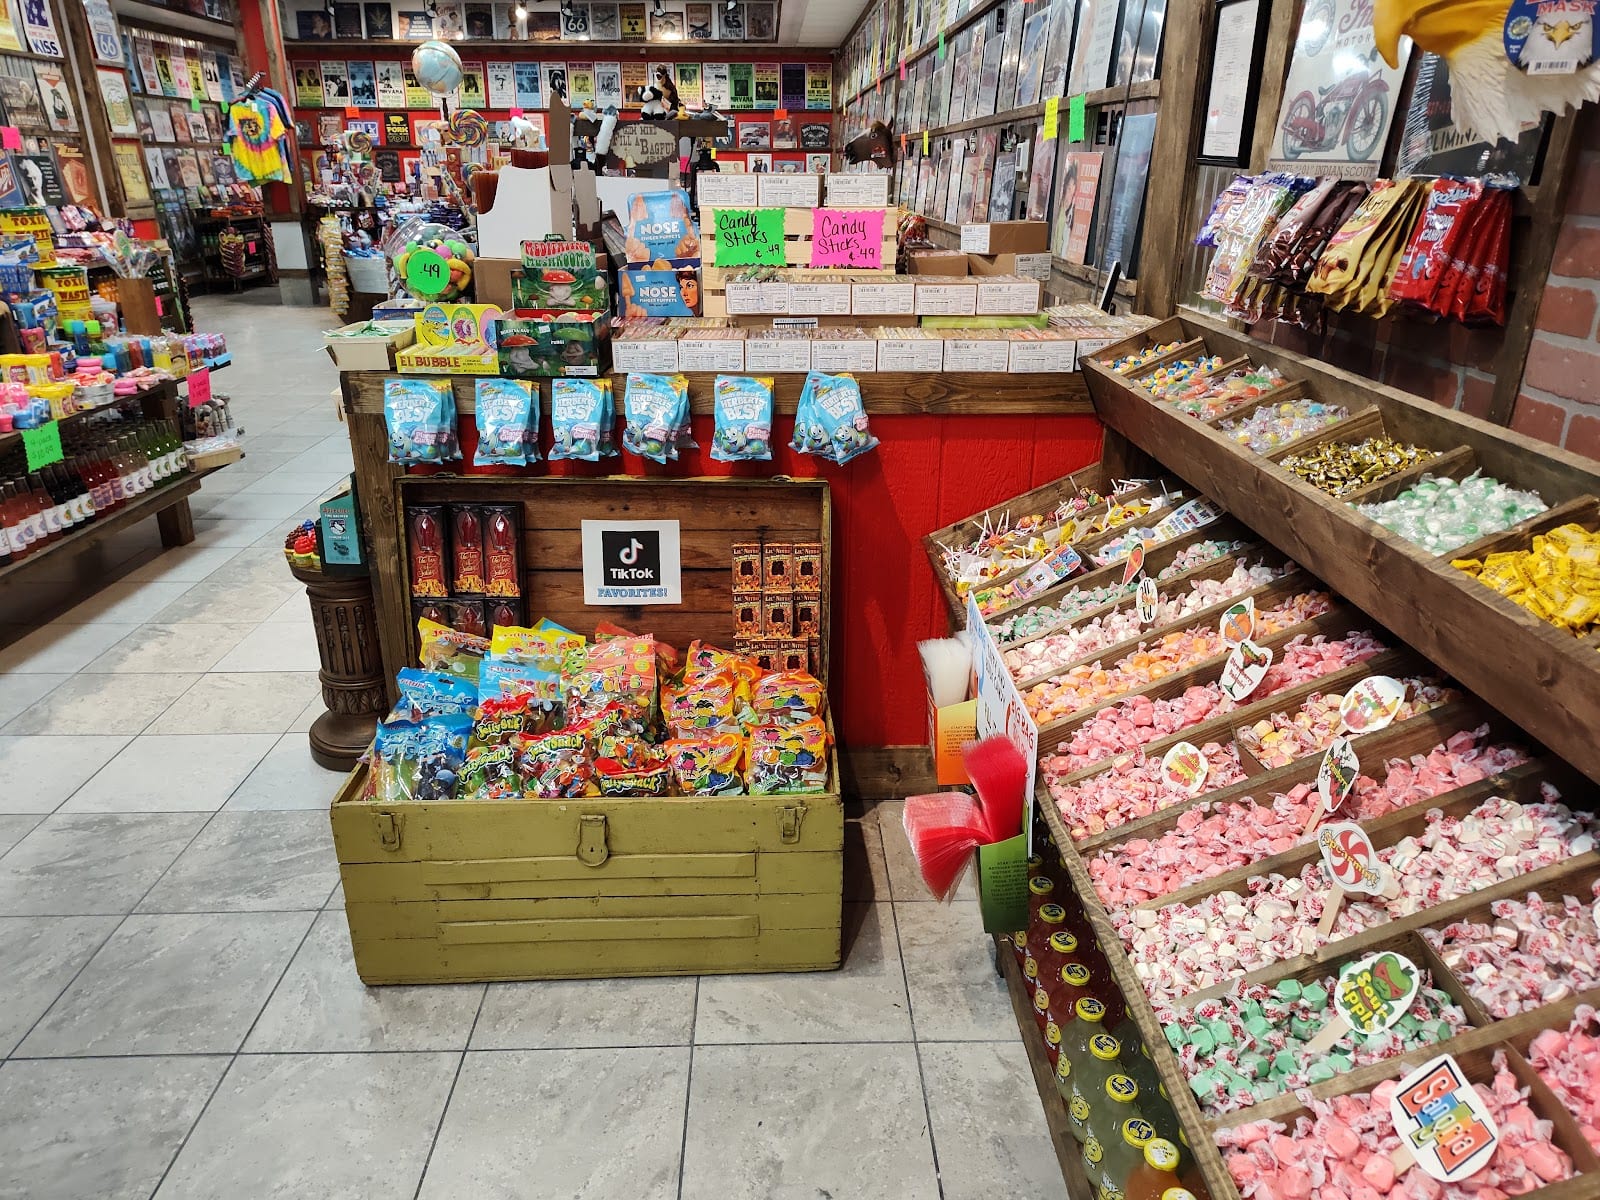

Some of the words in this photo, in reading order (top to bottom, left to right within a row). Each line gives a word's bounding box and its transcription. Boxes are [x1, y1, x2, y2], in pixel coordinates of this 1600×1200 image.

[1537, 1, 1595, 15] MASK
[568, 20, 584, 31] 66
[725, 15, 741, 28] 65
[32, 39, 58, 55] KISS
[100, 34, 117, 55] 66
[1316, 166, 1344, 176] INDIAN
[1346, 166, 1375, 178] SCOUT
[640, 221, 680, 235] NOSE
[719, 213, 758, 234] Candy
[821, 216, 866, 241] Candy
[724, 230, 768, 248] Sticks
[818, 237, 860, 255] Sticks
[525, 242, 590, 257] MEDITATING
[526, 252, 591, 267] MUSHROOMS
[640, 286, 677, 298] NOSE
[400, 357, 414, 366] EL
[415, 356, 460, 368] BUBBLE
[610, 568, 654, 580] TikTok
[597, 587, 668, 598] FAVORITES!
[1230, 657, 1253, 686] Strawberry
[1021, 717, 1035, 752] BAG
[1323, 831, 1378, 884] Spearmint
[1356, 971, 1388, 1019] Sour
[1341, 980, 1375, 1033] Apple
